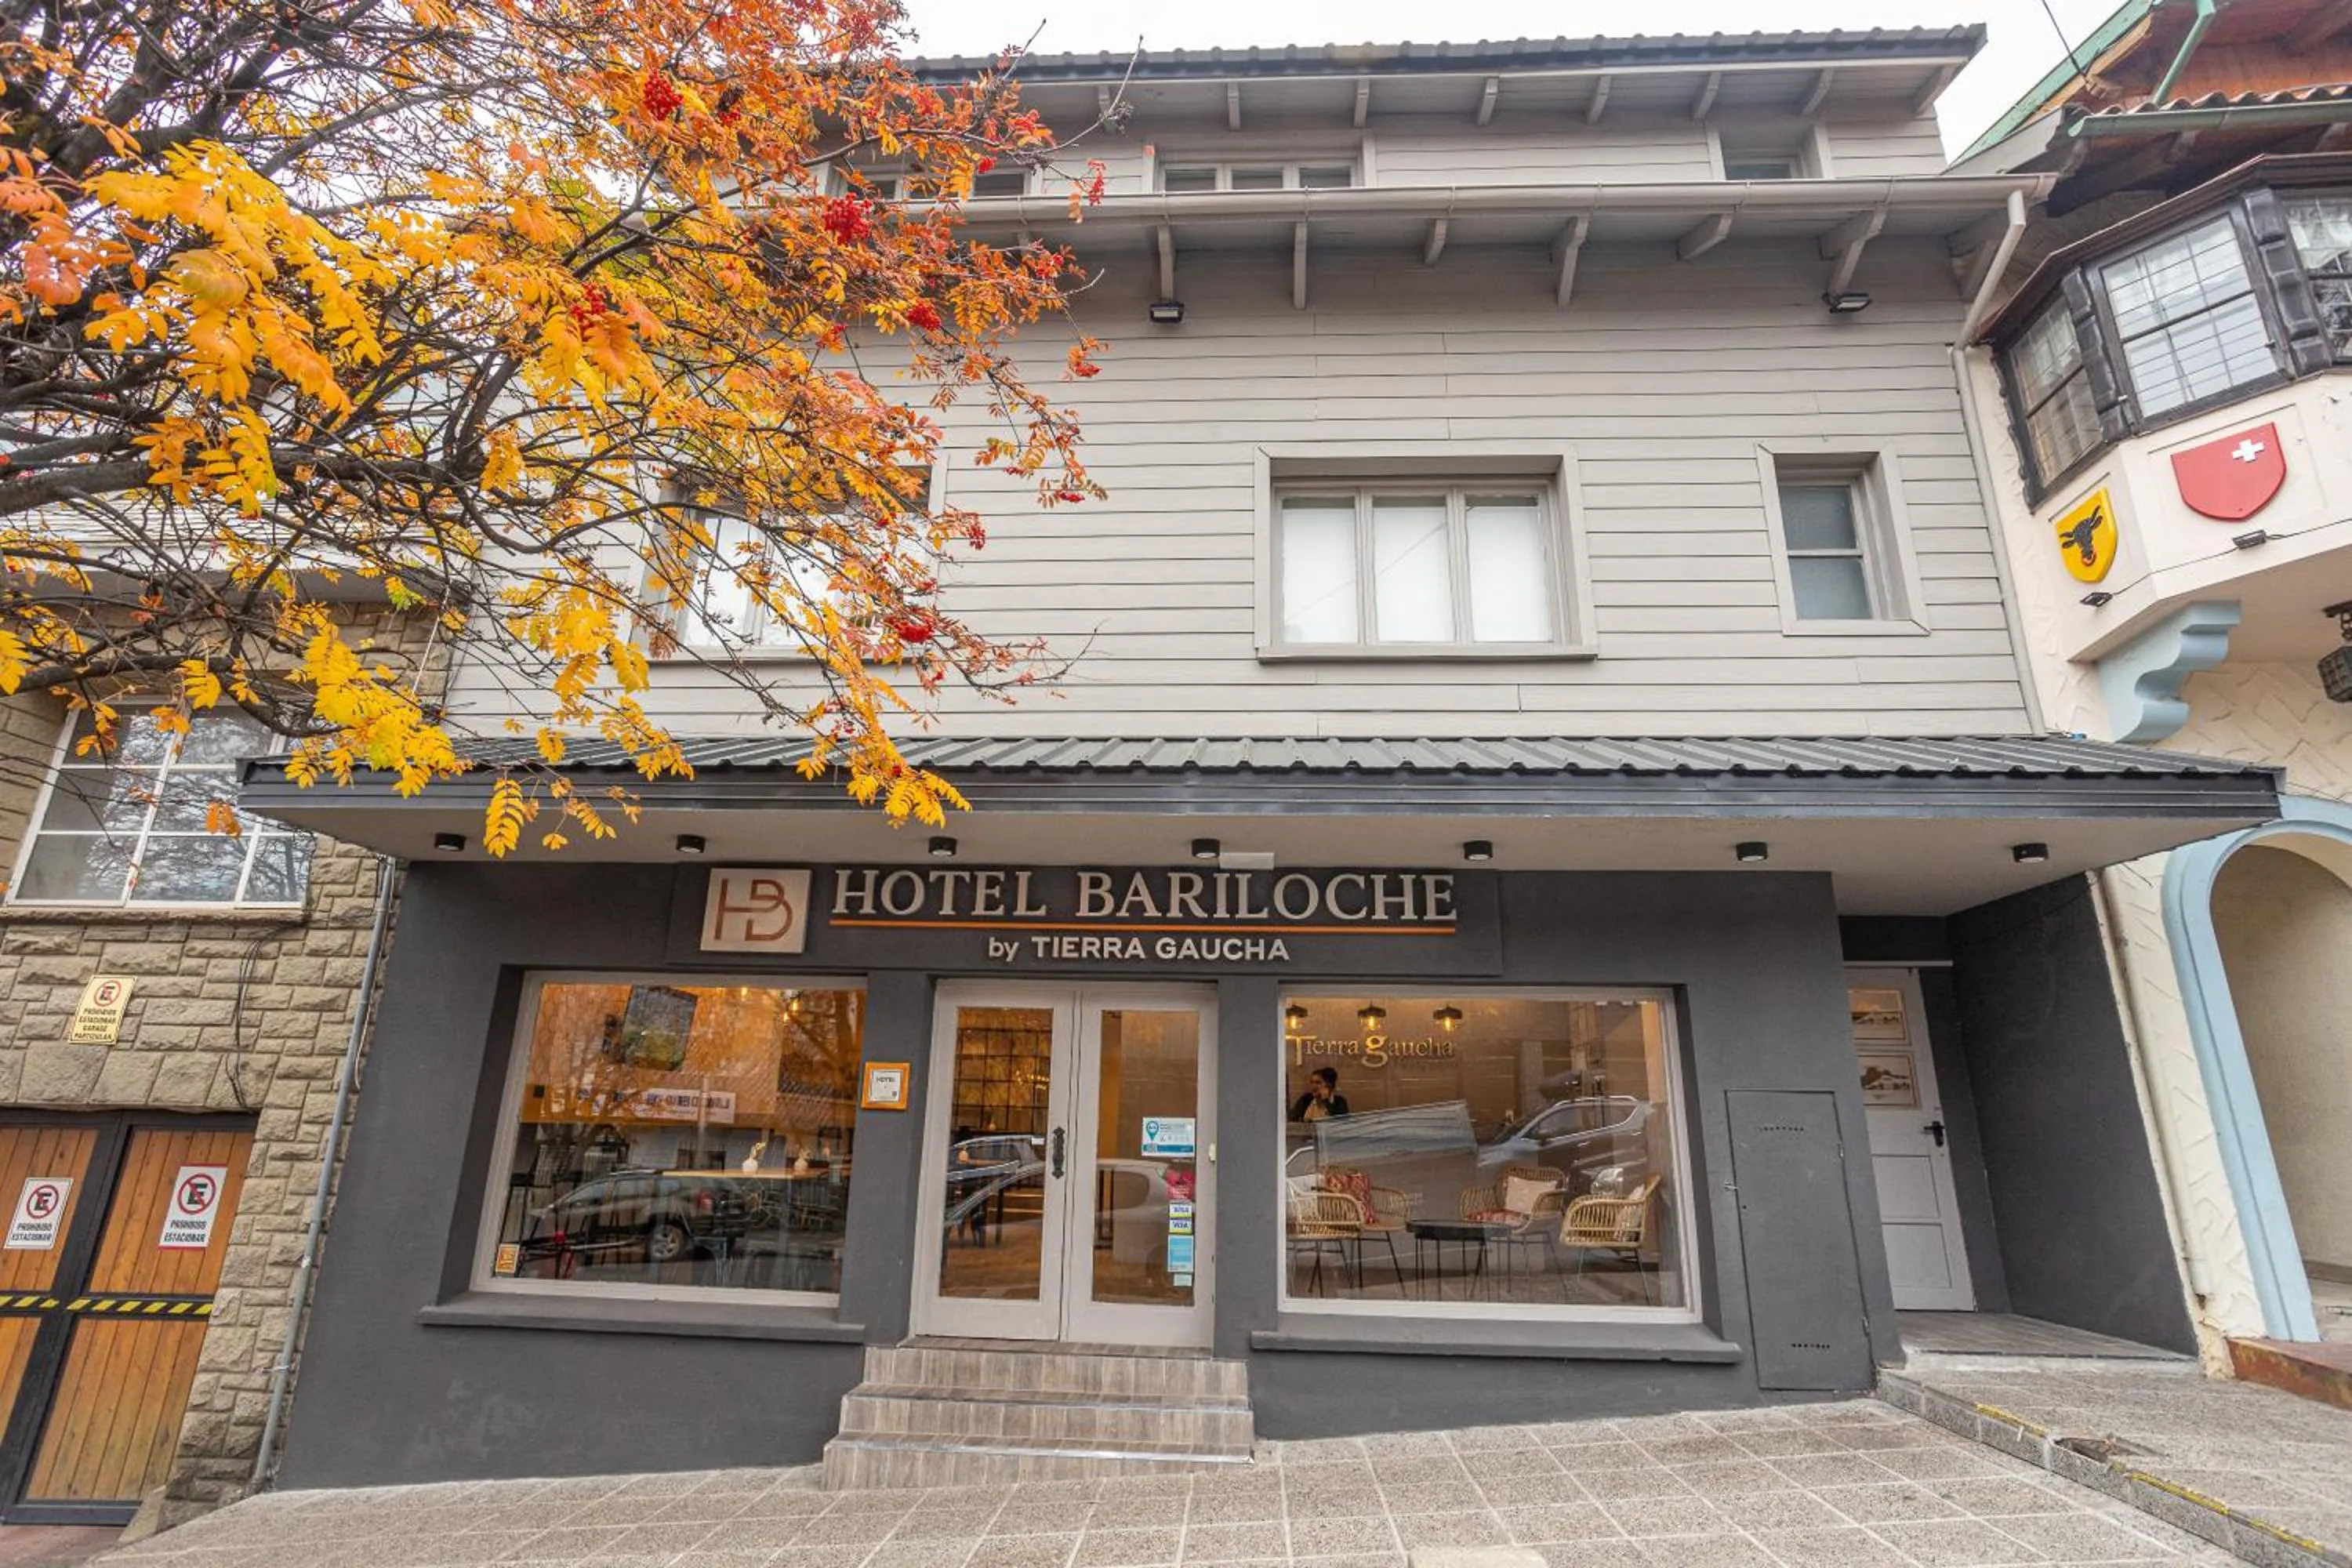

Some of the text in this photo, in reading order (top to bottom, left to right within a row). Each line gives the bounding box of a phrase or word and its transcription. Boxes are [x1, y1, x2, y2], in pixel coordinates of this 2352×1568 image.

[831, 869, 1457, 921] HOTEL BARILOCHE
[988, 936, 1290, 961] by TIERRA GAUCHA
[1286, 1034, 1454, 1068] Tierra gaucha
[164, 1232, 205, 1243] ESTACIONAR
